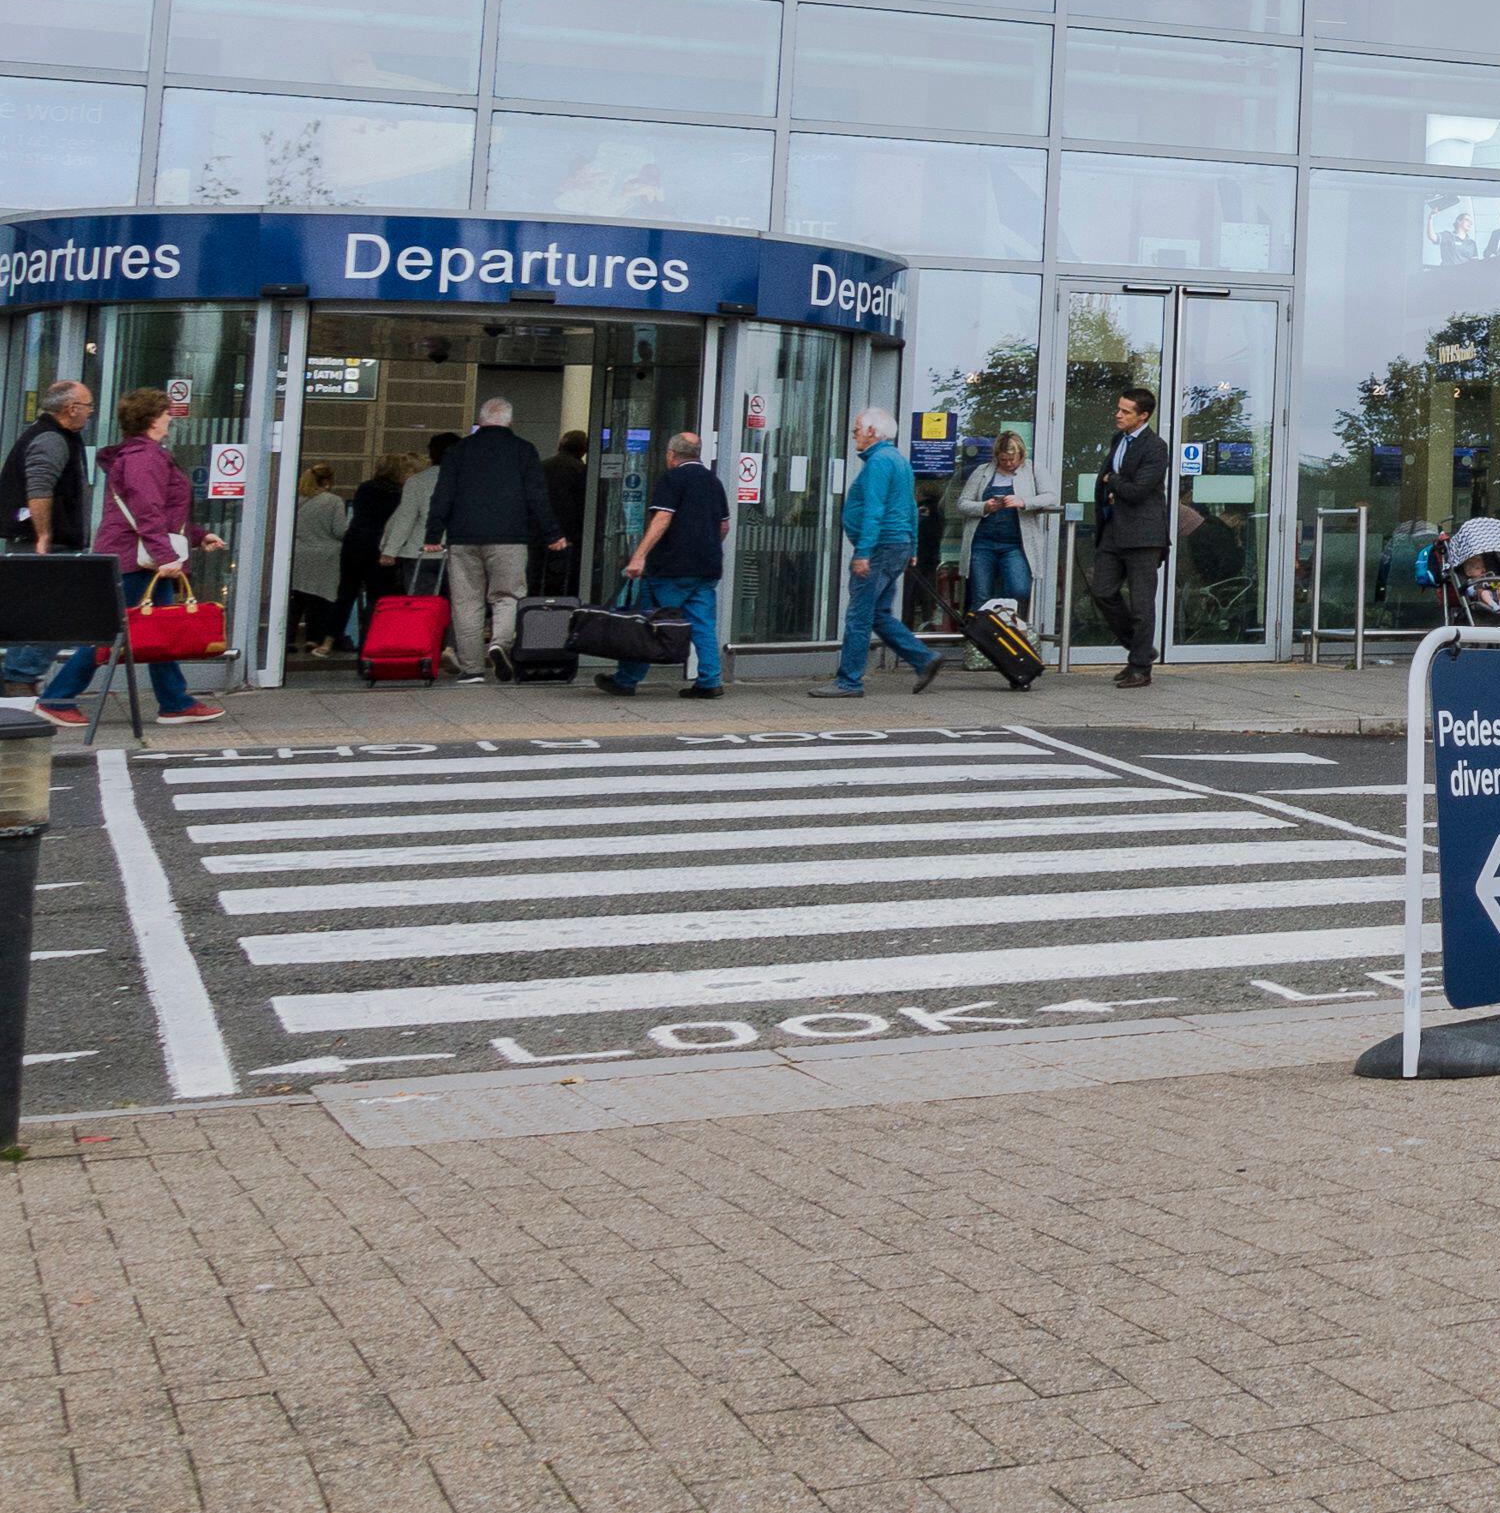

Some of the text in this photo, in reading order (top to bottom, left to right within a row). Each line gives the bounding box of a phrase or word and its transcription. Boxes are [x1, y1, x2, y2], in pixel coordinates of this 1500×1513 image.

[0, 238, 181, 297] epartures
[344, 233, 690, 293] Departures
[193, 727, 962, 761] LOOK RIGHT
[490, 1000, 1028, 1065] LOOK
